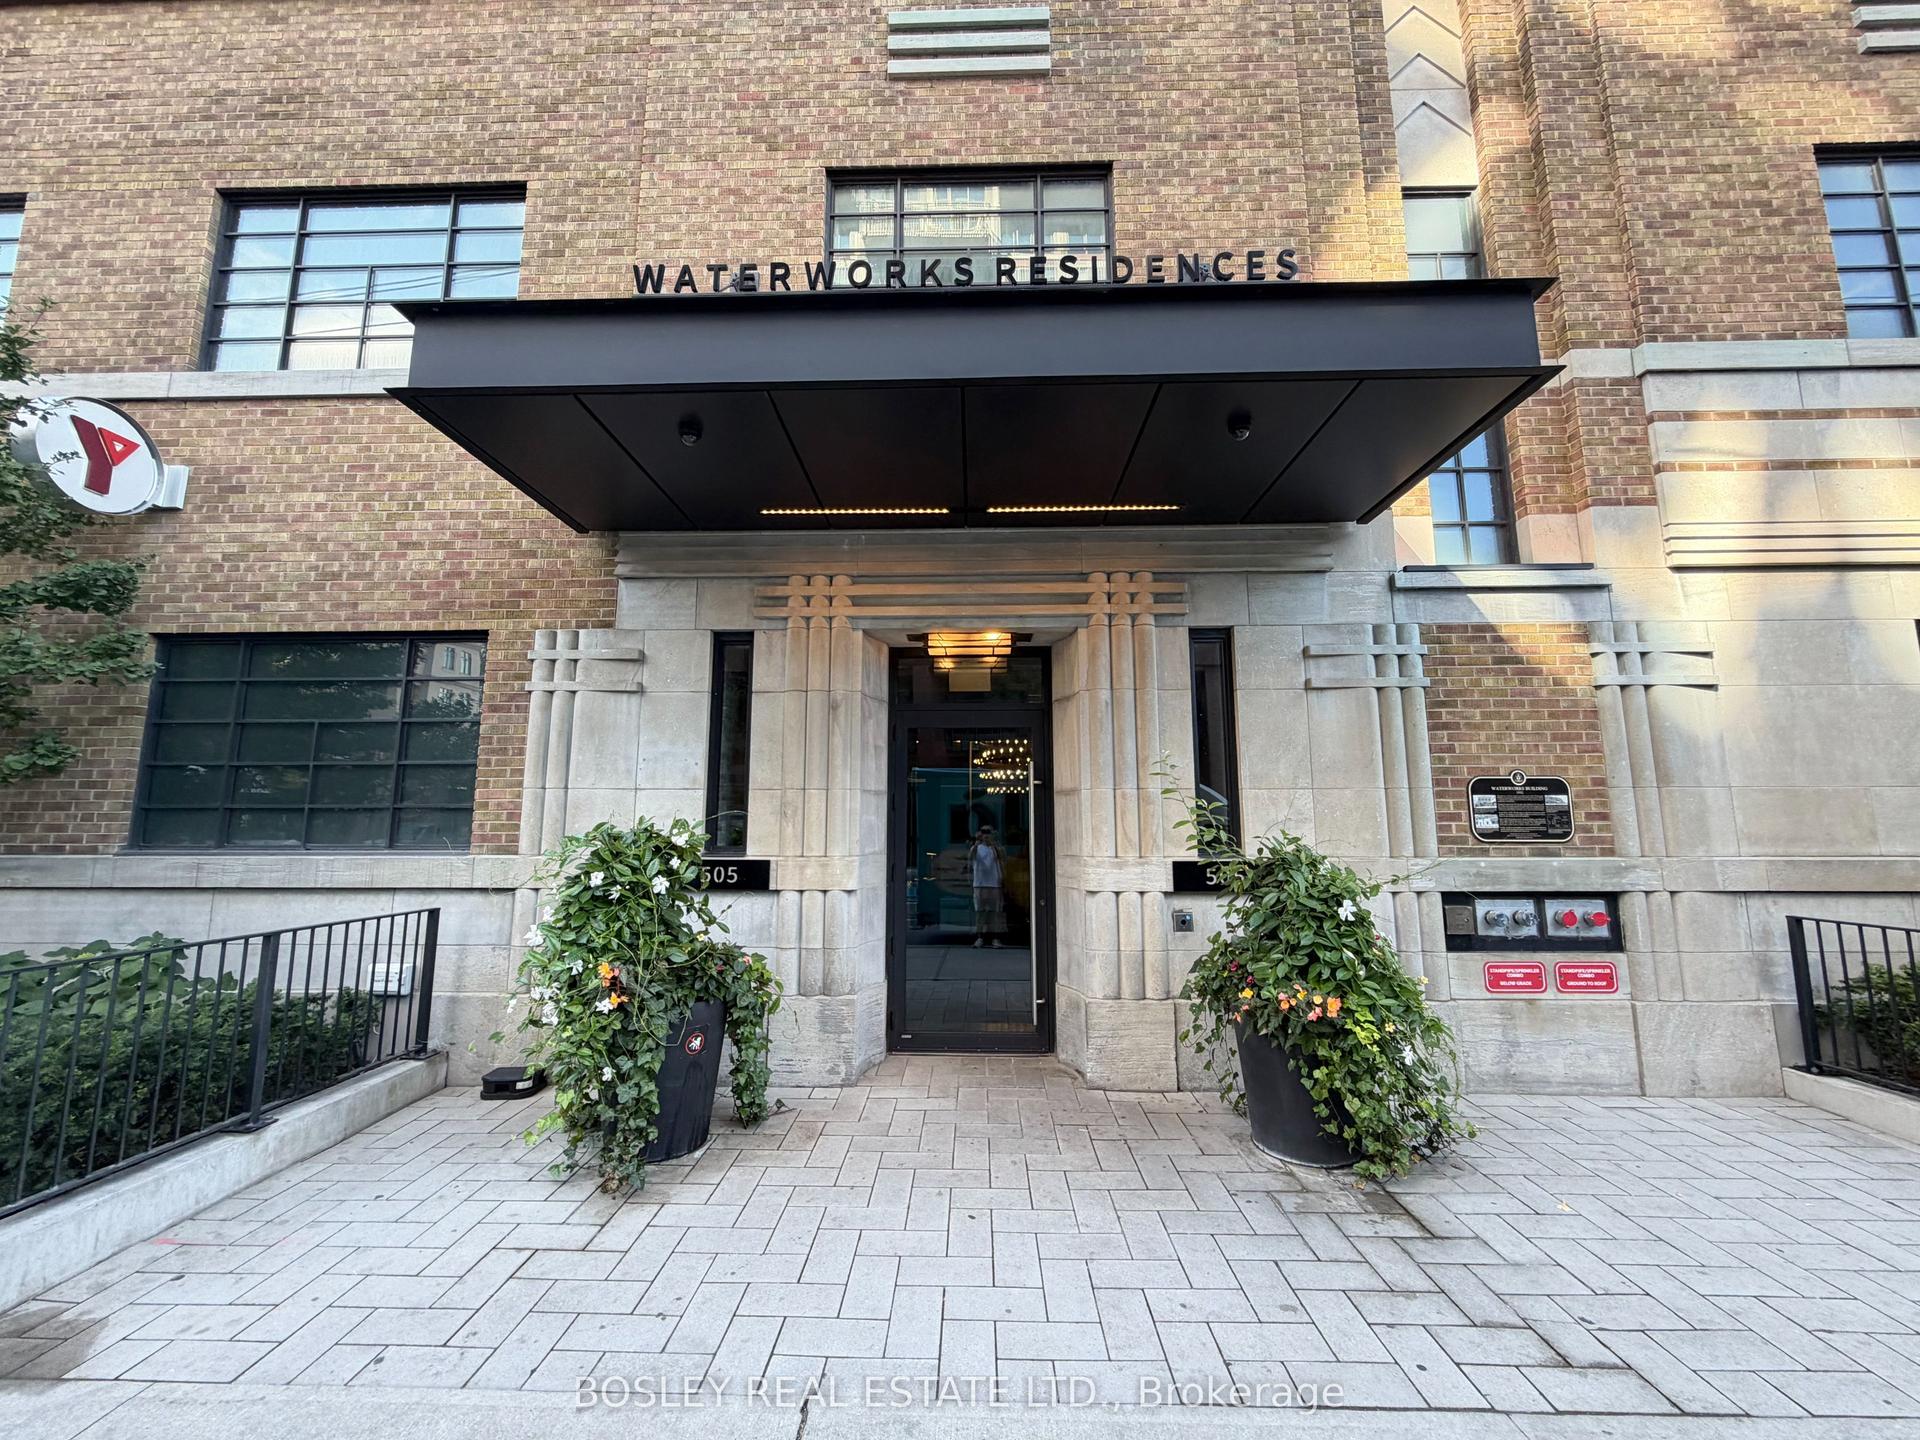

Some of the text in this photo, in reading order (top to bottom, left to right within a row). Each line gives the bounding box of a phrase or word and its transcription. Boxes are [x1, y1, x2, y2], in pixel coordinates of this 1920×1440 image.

[633, 249, 1299, 294] WATERWORKS RESIDENCES
[701, 866, 738, 883] 505
